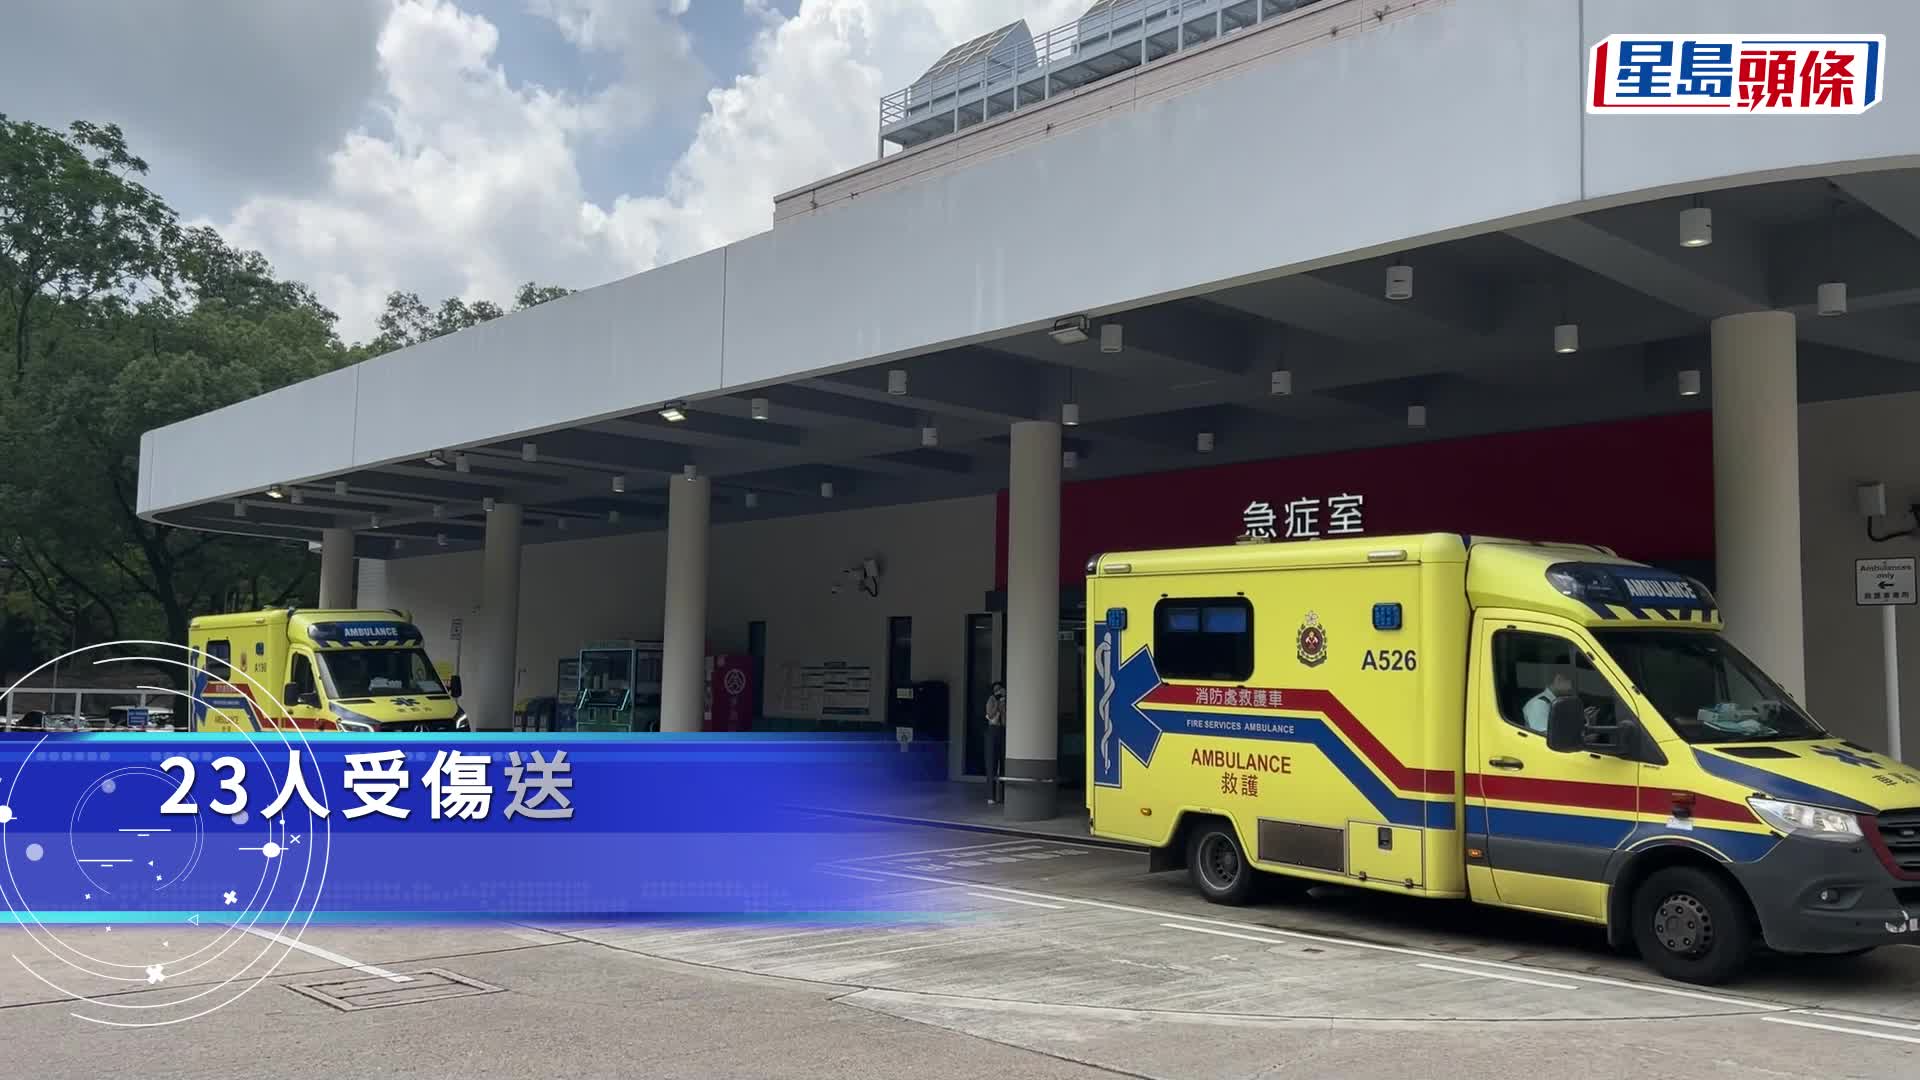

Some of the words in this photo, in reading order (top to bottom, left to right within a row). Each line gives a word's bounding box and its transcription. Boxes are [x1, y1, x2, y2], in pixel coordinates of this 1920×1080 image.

[1243, 493, 1364, 538] 急症室
[1624, 578, 1697, 599] AMBULANCE
[344, 627, 399, 637] AMBULANCE
[1361, 649, 1417, 671] A526
[1195, 687, 1283, 708] 消防處救護車
[1186, 719, 1203, 728] FIRE
[1204, 720, 1241, 731] SERVICES
[1244, 722, 1295, 734] AMBULANCE
[1191, 747, 1292, 775] AMBULANCE
[1221, 771, 1259, 798] 救護
